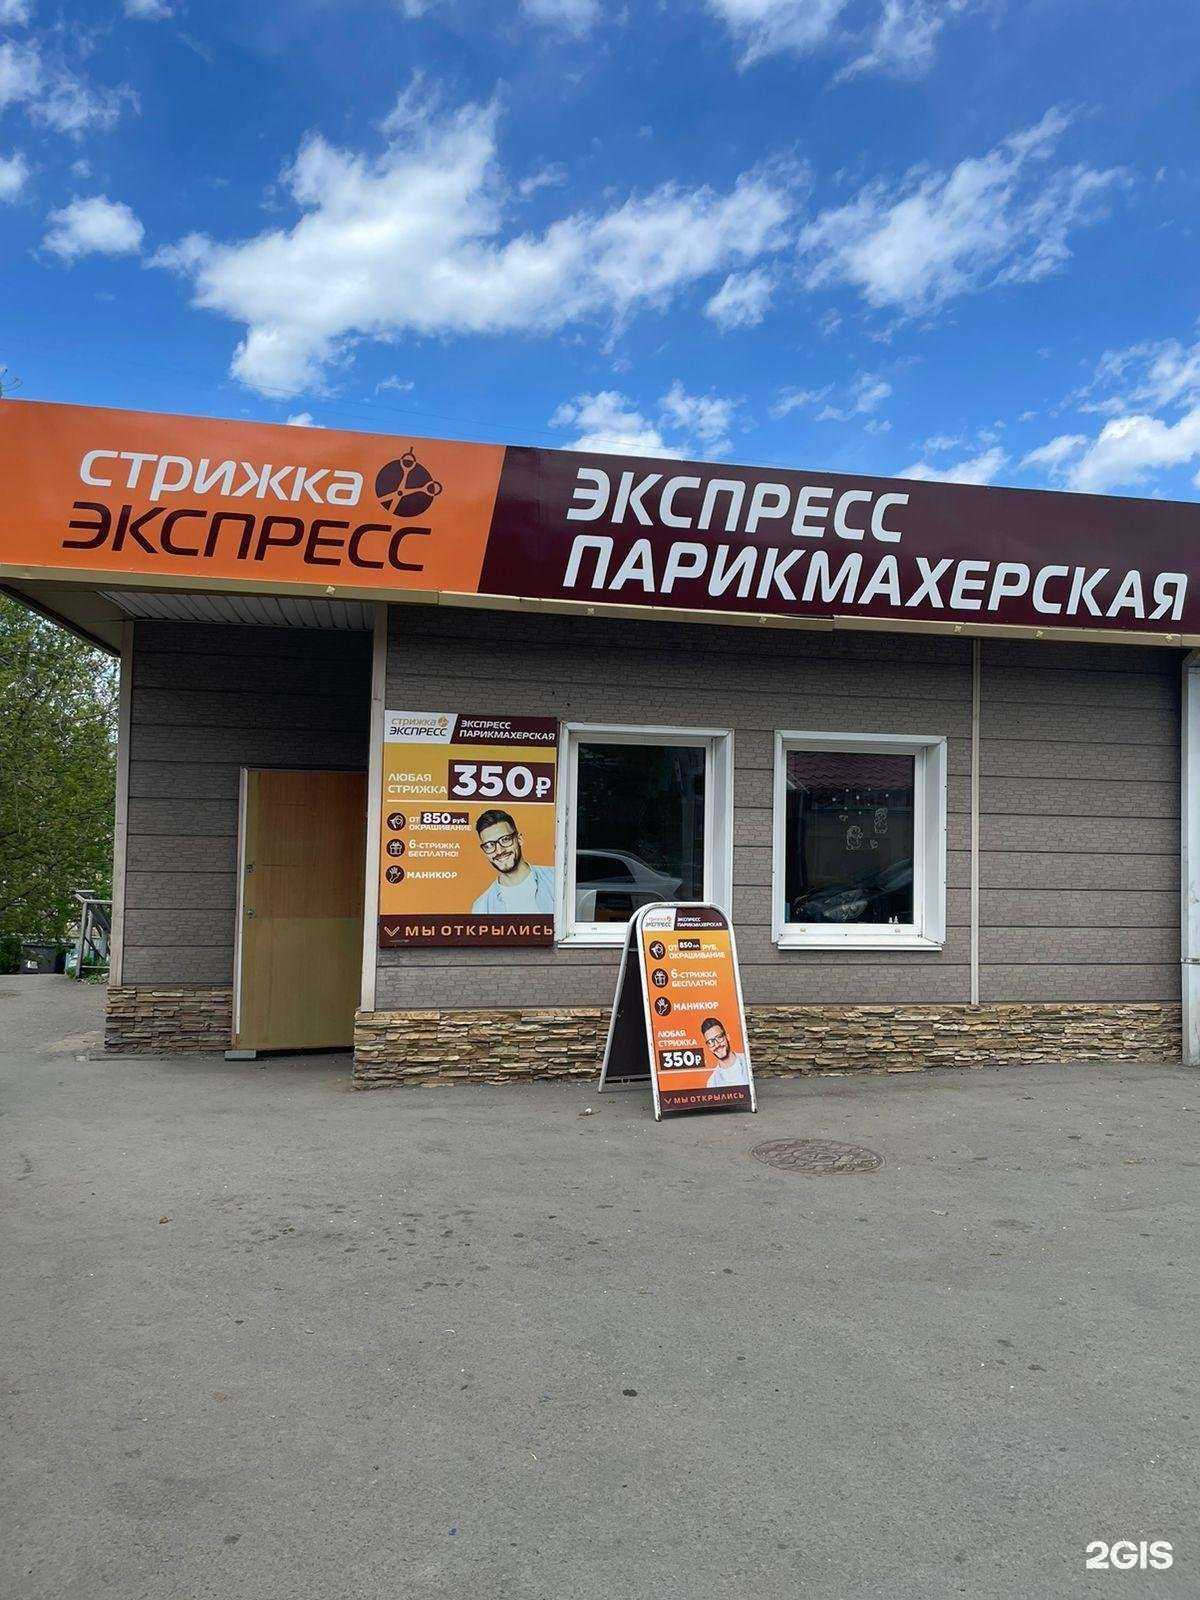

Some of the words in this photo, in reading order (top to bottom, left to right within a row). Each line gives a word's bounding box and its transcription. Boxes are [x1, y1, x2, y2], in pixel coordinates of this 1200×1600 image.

[80, 449, 364, 506] стрижка
[566, 467, 910, 543] ЭКСПРЕСС
[62, 501, 432, 572] ЭКСПРЕСС
[563, 534, 1188, 621] ПАРИКМАХЕРСКАЯ
[461, 719, 511, 730] ЭКСПРЕСС
[389, 726, 448, 737] ЭКСПРЕСС
[459, 730, 556, 740] ПАРИКМАХЕРСКАЯ
[388, 773, 432, 782] ЛЮБАЯ
[388, 785, 448, 794] СТРИЖКА
[423, 812, 451, 824] 850
[408, 824, 472, 832] ОКРАШИВАНИЕ
[406, 871, 458, 879] МАНИКЮР
[405, 926, 435, 936] МЫ
[441, 925, 553, 936] ОТКРЫЛИСЬ
[673, 1001, 719, 1011] МАНИКЮР
[657, 1029, 686, 1038] ЛЮБАЯ
[658, 1038, 698, 1047] СТРИЖКА
[691, 1092, 744, 1103] ОТКРЫЛИСЬ
